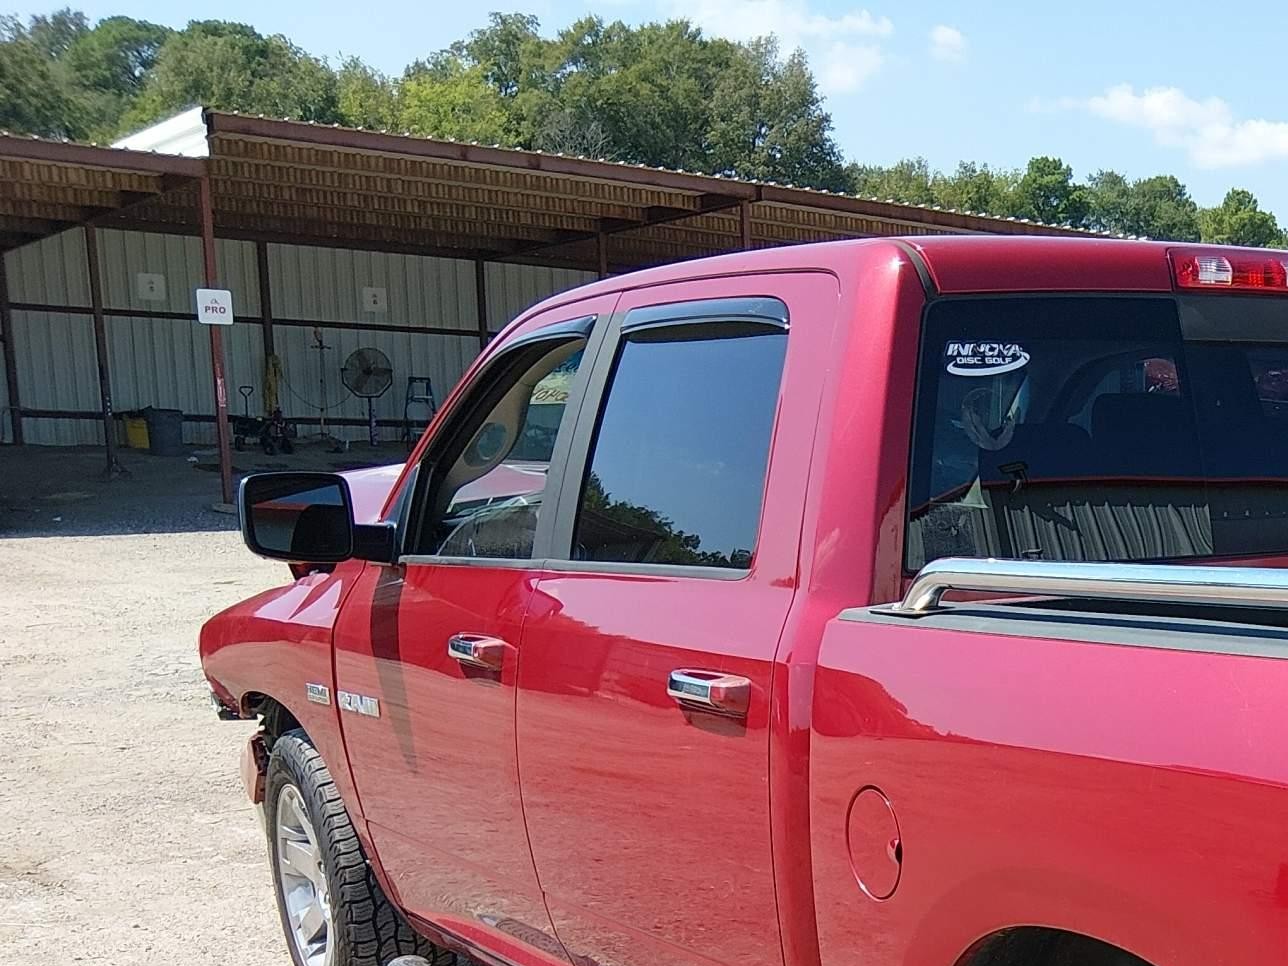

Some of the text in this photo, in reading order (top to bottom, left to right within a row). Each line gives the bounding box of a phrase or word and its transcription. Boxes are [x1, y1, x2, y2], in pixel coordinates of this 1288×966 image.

[204, 305, 227, 314] PRO
[946, 343, 1021, 356] INNOVA
[956, 356, 1013, 364] DISC GOLF
